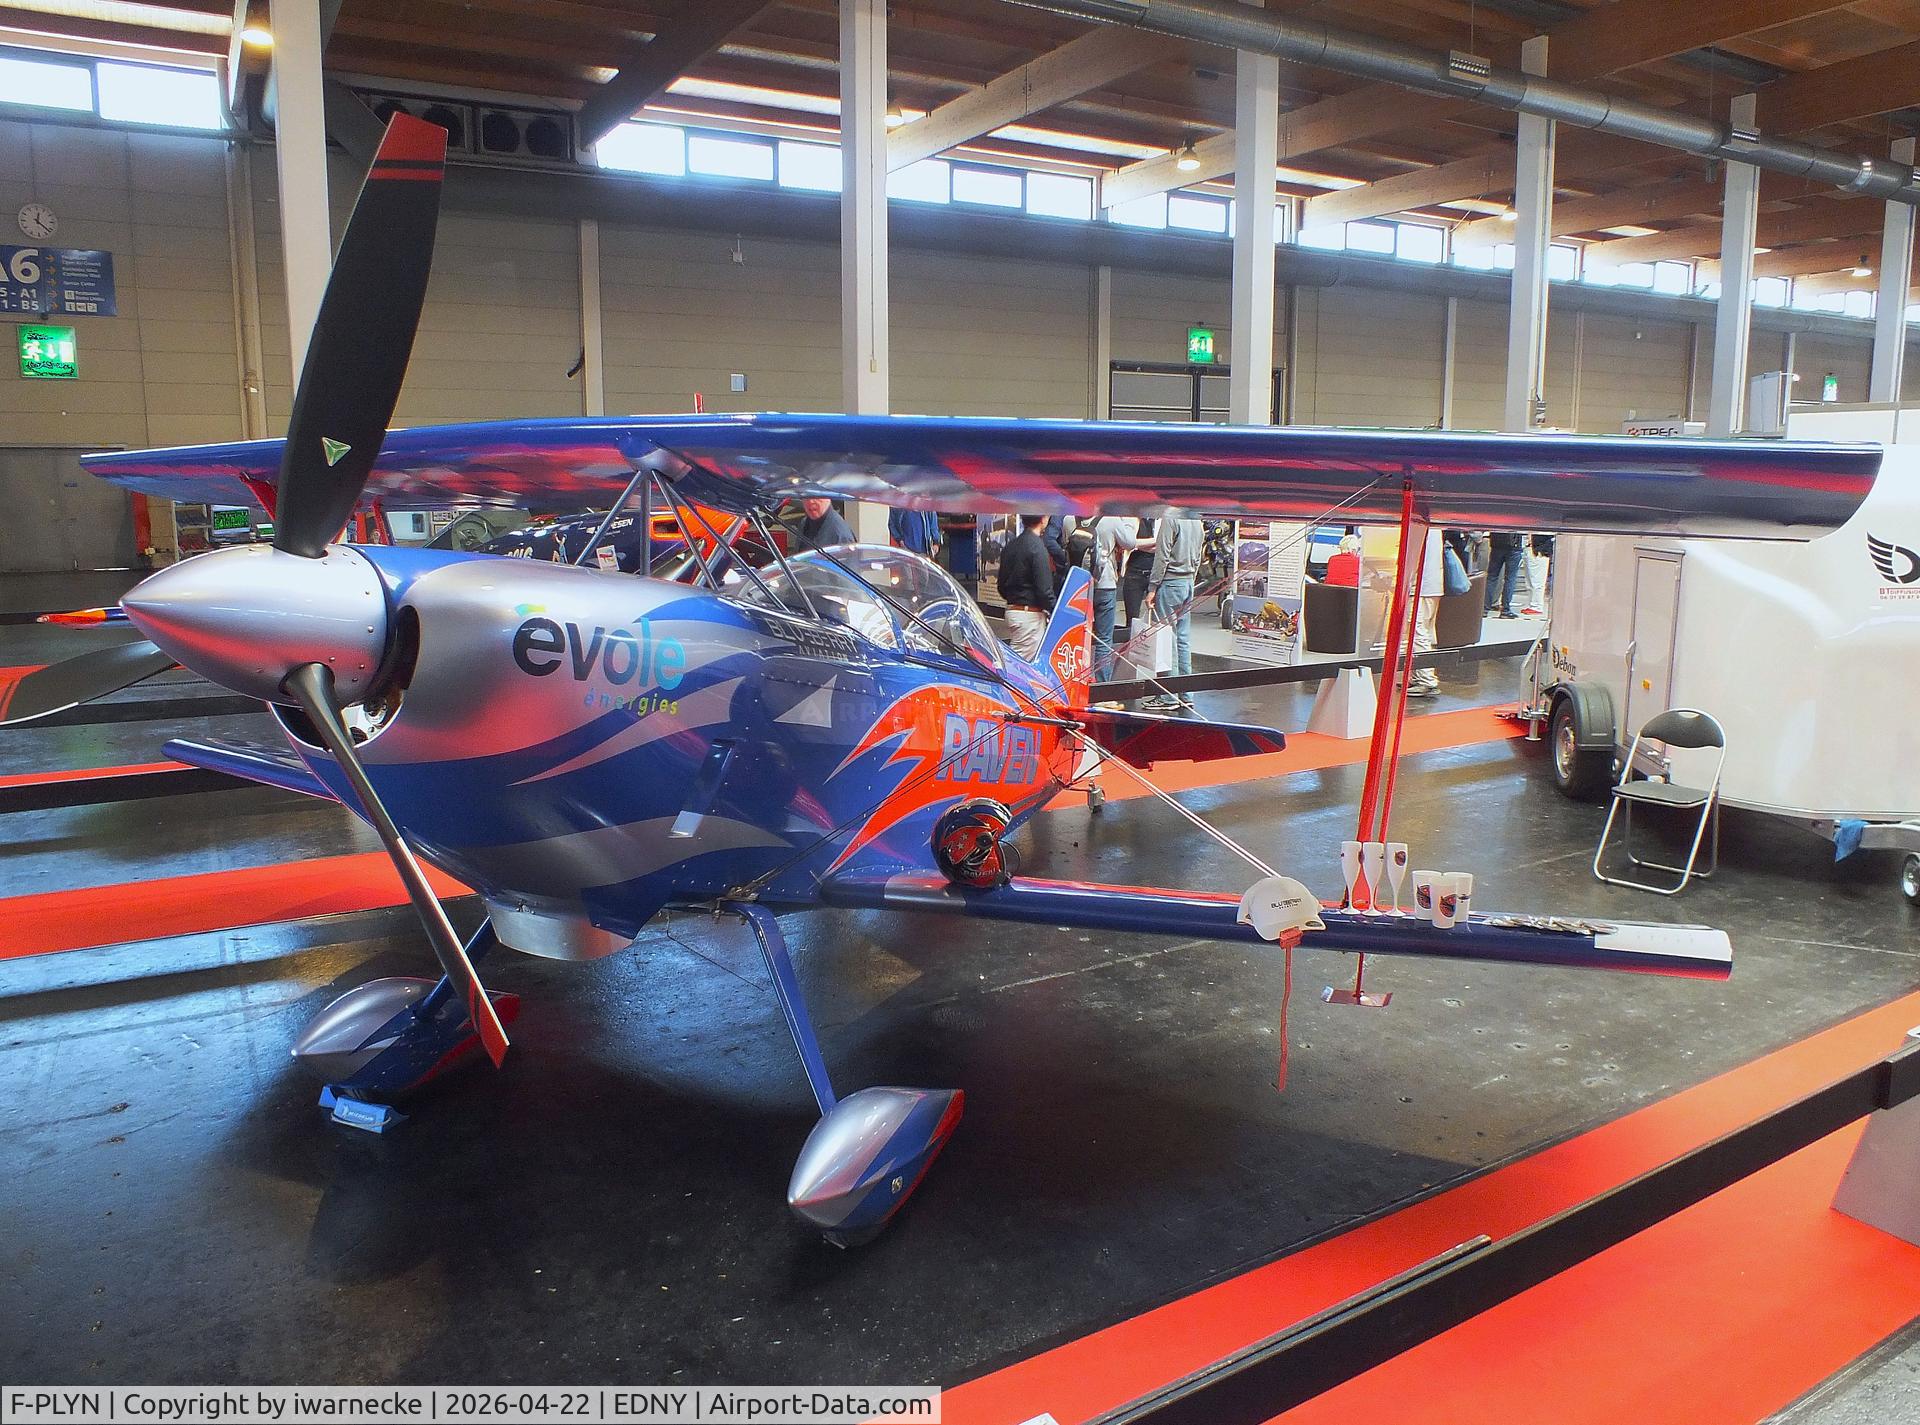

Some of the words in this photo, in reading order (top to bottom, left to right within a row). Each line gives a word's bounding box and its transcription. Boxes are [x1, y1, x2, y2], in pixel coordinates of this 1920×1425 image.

[20, 288, 37, 298] A1
[22, 300, 39, 311] B5
[935, 711, 1042, 785] RAVEN
